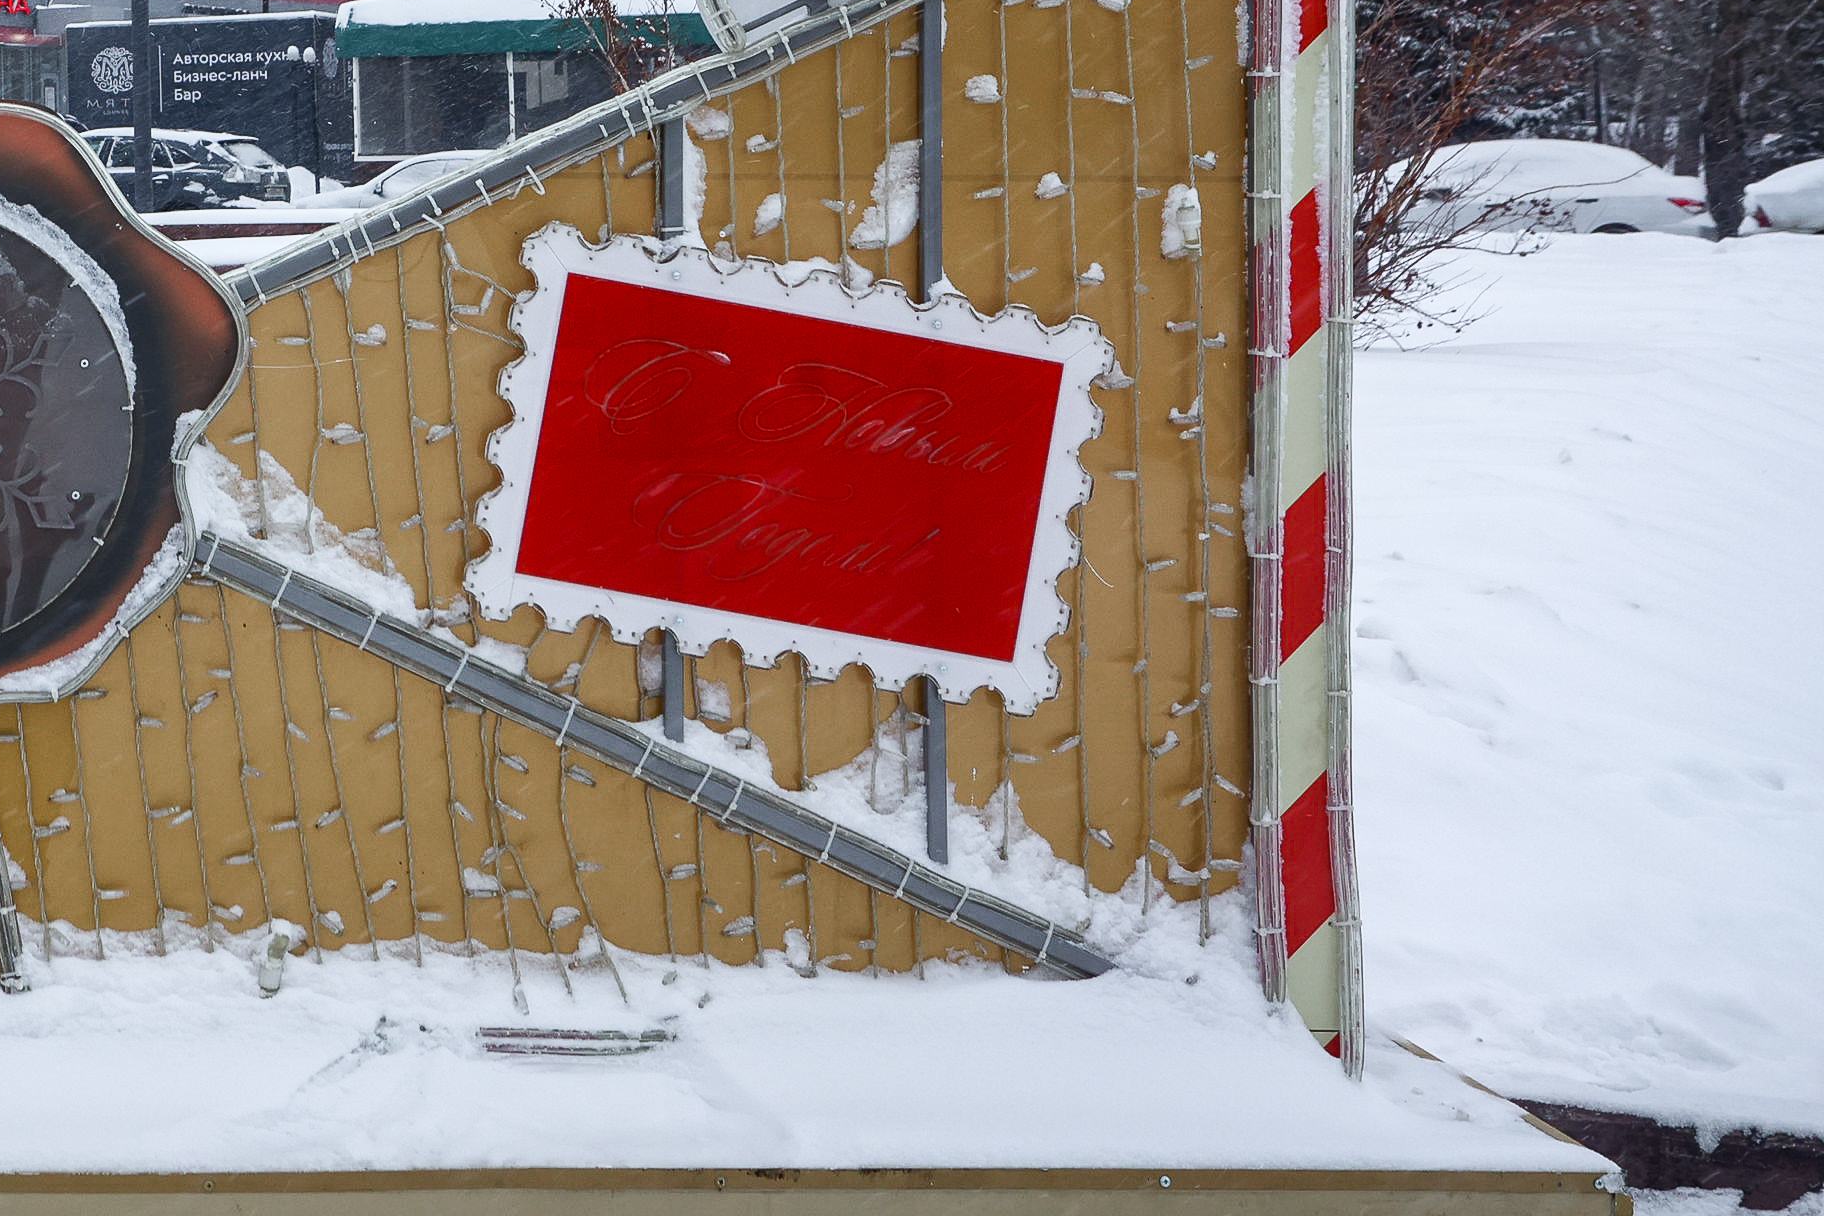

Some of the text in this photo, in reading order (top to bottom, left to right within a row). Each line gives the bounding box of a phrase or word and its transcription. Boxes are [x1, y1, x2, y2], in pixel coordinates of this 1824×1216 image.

[172, 50, 291, 67] Авторская кухн
[173, 69, 269, 84] Бизнес-ланч
[86, 98, 132, 109] МЯТ
[174, 88, 203, 104] Бар
